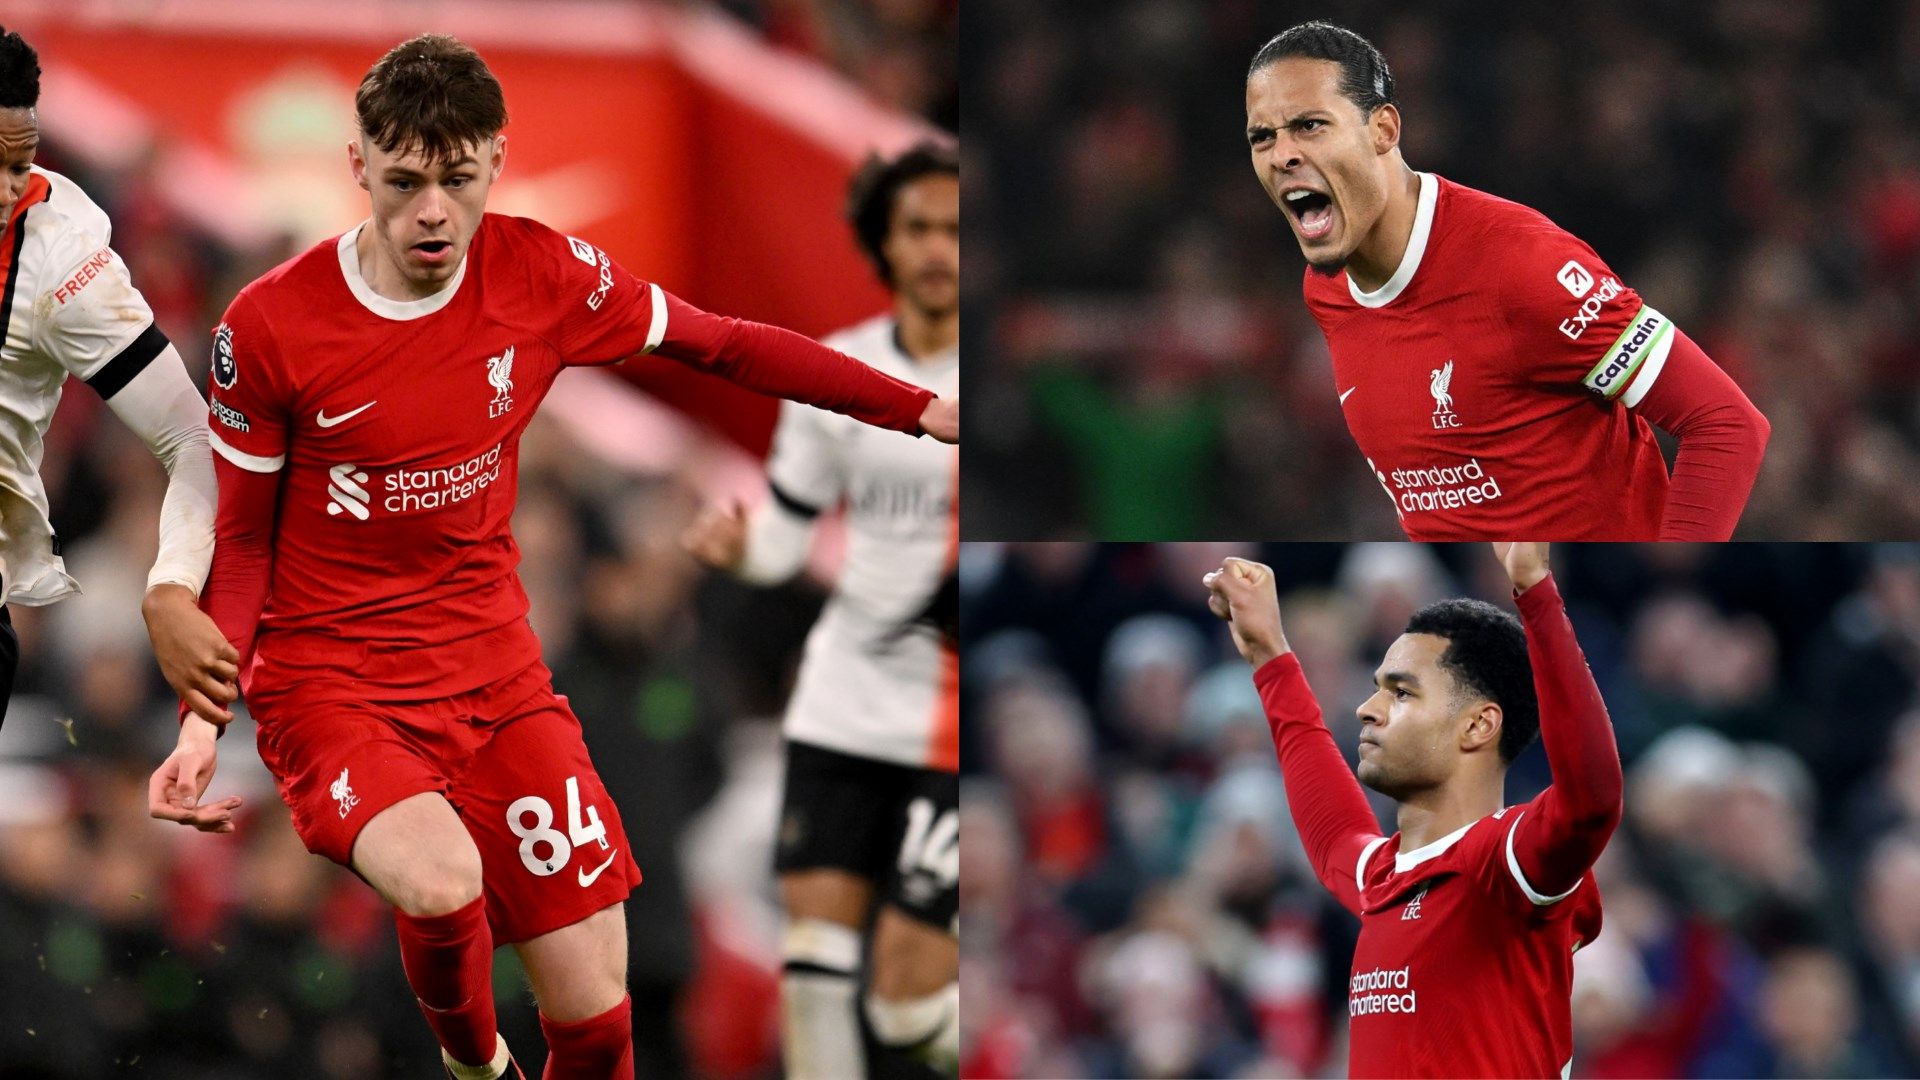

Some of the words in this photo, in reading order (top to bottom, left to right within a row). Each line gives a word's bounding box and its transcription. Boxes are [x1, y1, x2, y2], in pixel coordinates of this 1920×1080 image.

[587, 246, 614, 311] Expe
[1595, 317, 1659, 387] Captain
[384, 459, 502, 512] chartered
[1391, 458, 1484, 489] standard
[1402, 476, 1502, 512] chartered
[507, 776, 609, 876] 84
[1352, 965, 1409, 994] standard
[1350, 989, 1416, 1017] chartered
